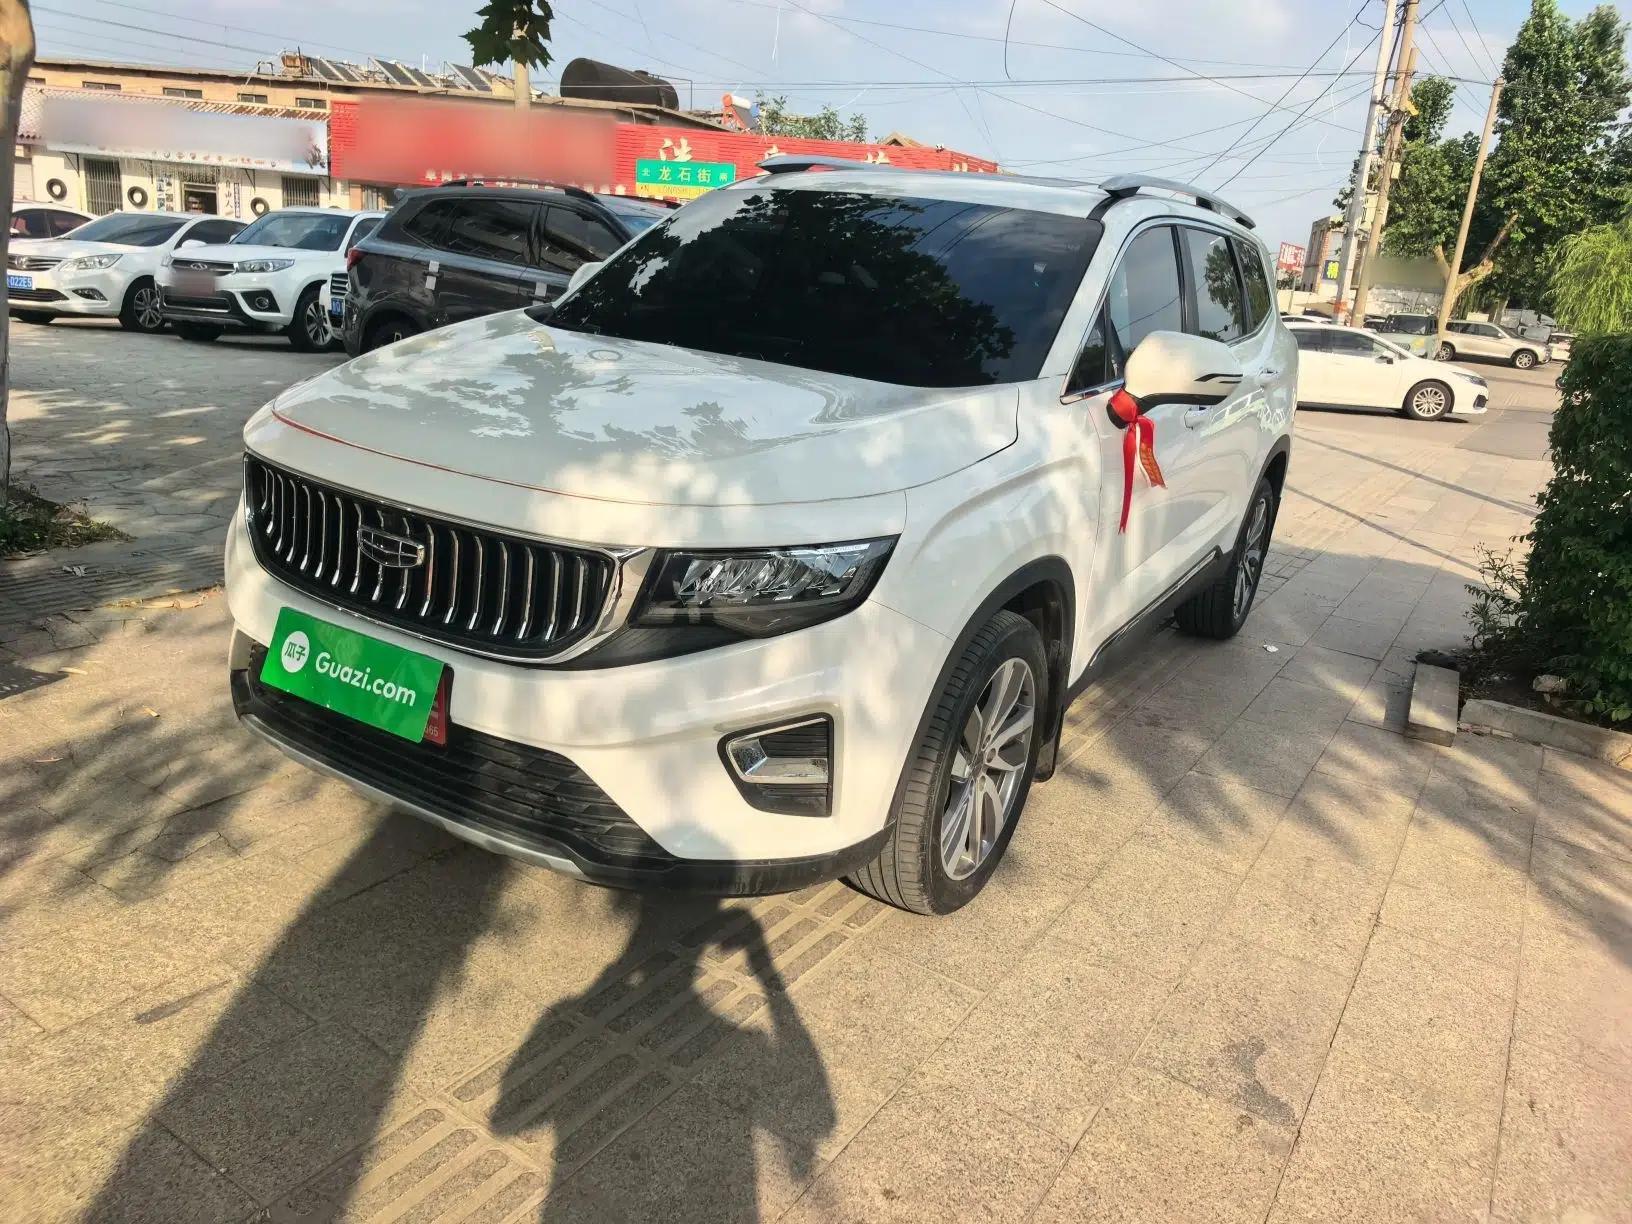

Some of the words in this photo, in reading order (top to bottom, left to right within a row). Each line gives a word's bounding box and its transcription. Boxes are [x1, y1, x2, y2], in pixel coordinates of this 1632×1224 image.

[659, 166, 712, 183] 龙石街
[284, 642, 306, 661] 瓜子
[315, 651, 417, 707] Guazi.com
